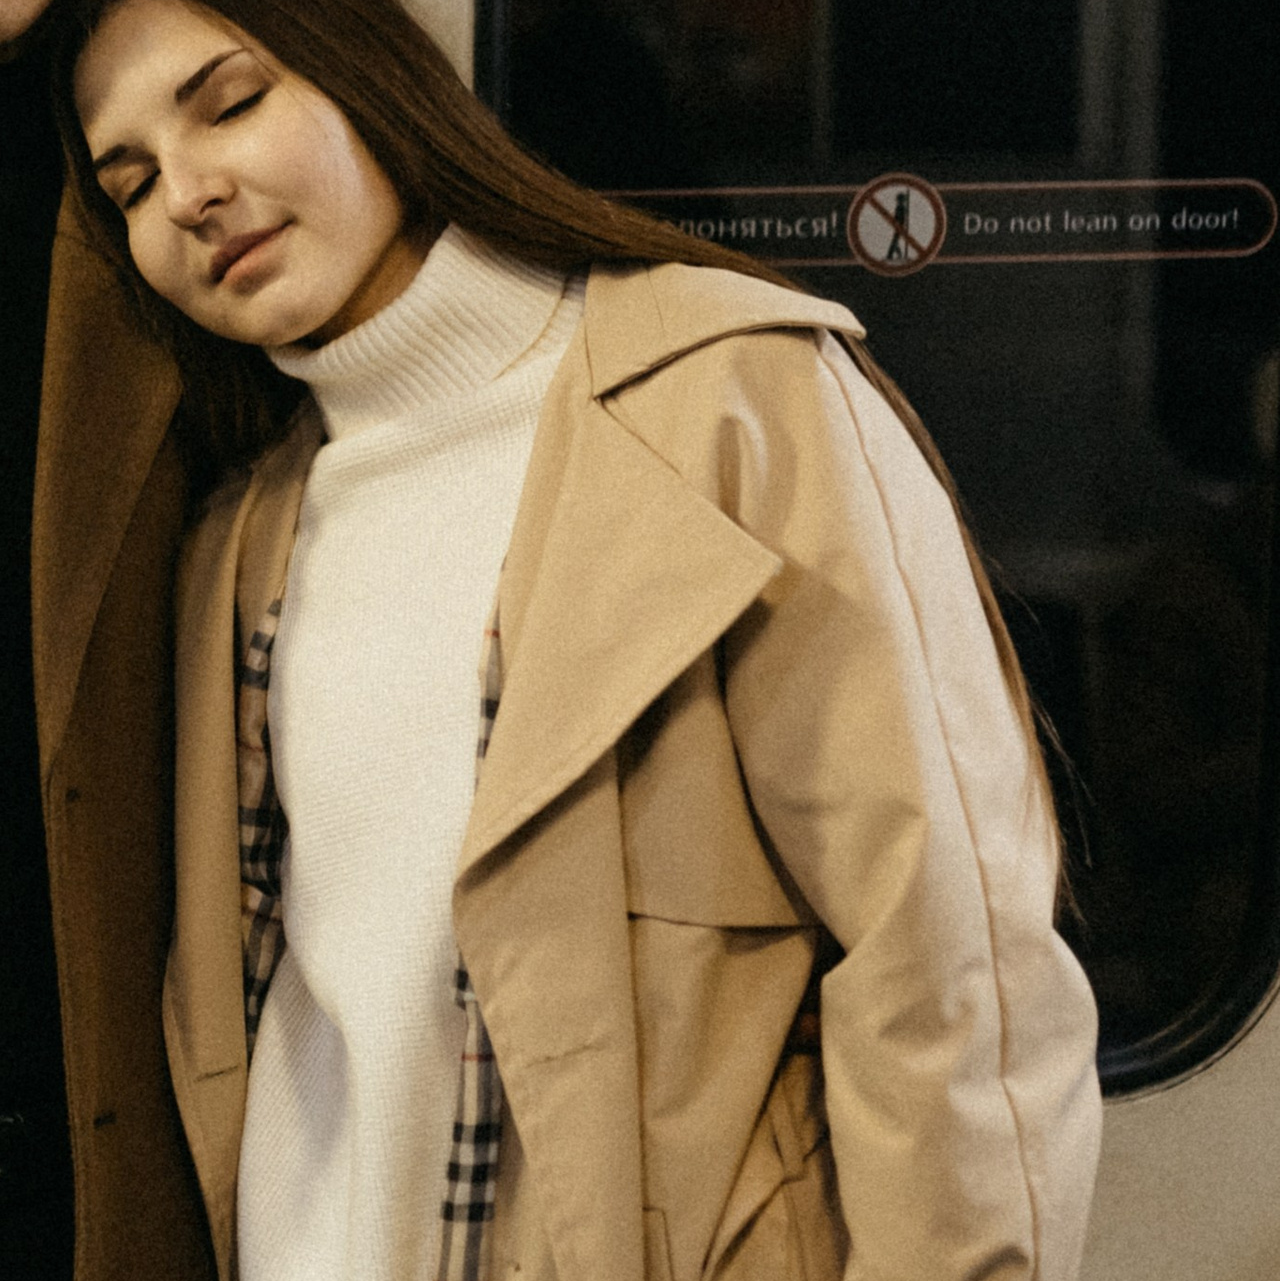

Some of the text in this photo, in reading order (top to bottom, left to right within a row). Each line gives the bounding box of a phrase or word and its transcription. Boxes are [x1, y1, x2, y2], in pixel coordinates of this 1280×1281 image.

[665, 209, 838, 239] лоняться!
[963, 206, 1239, 236] Do not lean on door!
